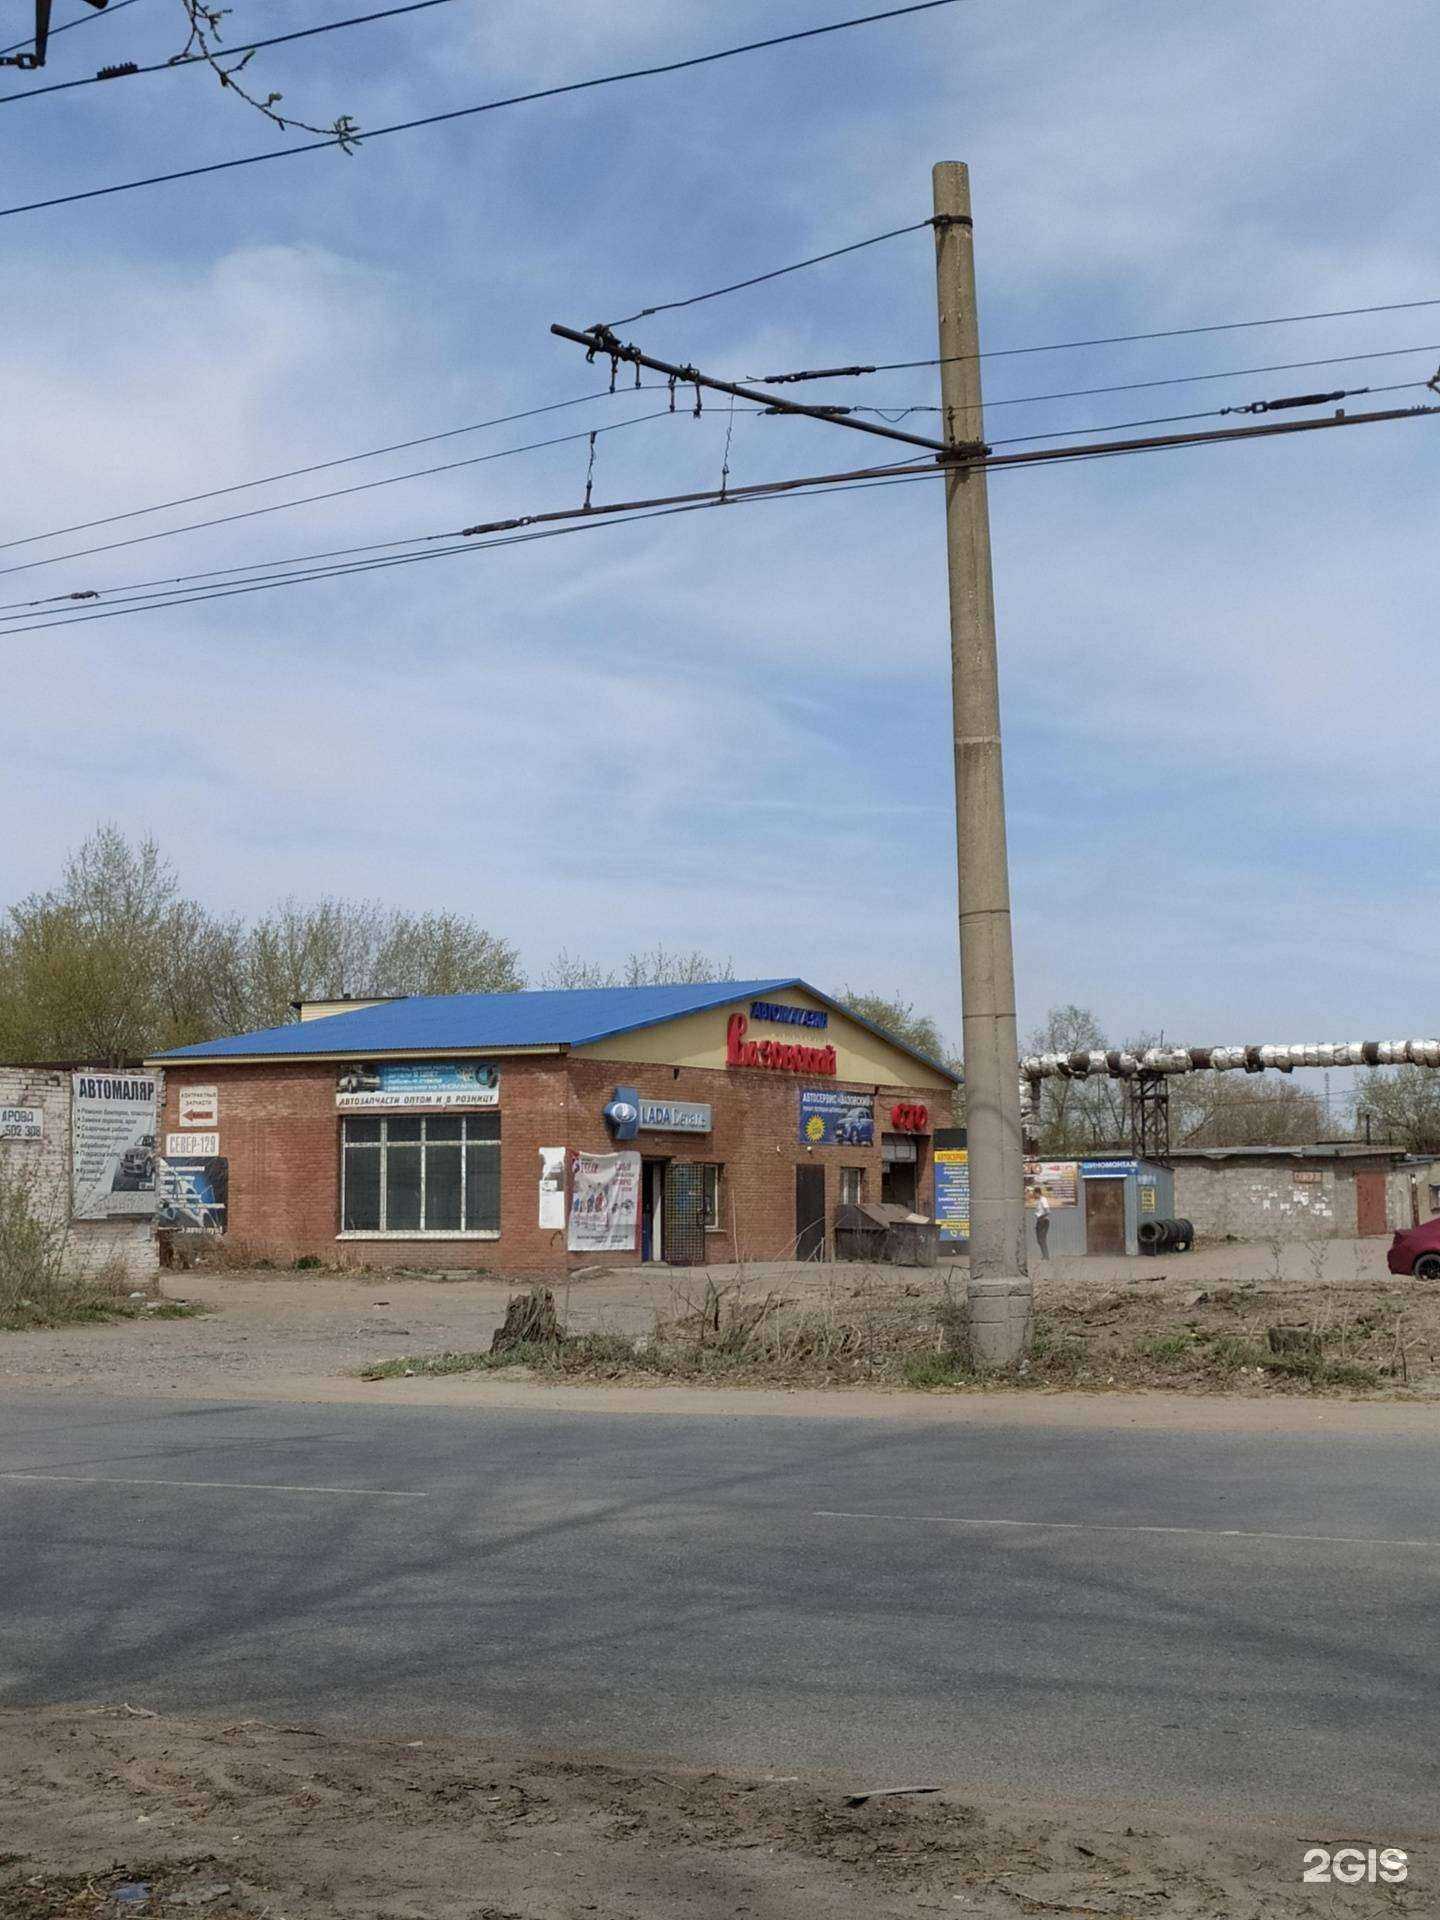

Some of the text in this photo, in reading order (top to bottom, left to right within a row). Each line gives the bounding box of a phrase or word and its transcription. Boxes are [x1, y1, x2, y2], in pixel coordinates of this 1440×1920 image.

[79, 1078, 154, 1101] АВТОМАЛЯР
[339, 1095, 494, 1106] АВТОЗАПЧАСТИ ОПТОМ И В РОЗНИЦУ
[640, 1106, 670, 1125] LADA
[169, 1135, 216, 1153] СЕВЕР-129
[1083, 1160, 1138, 1169] ШИНОМОНТАЖ
